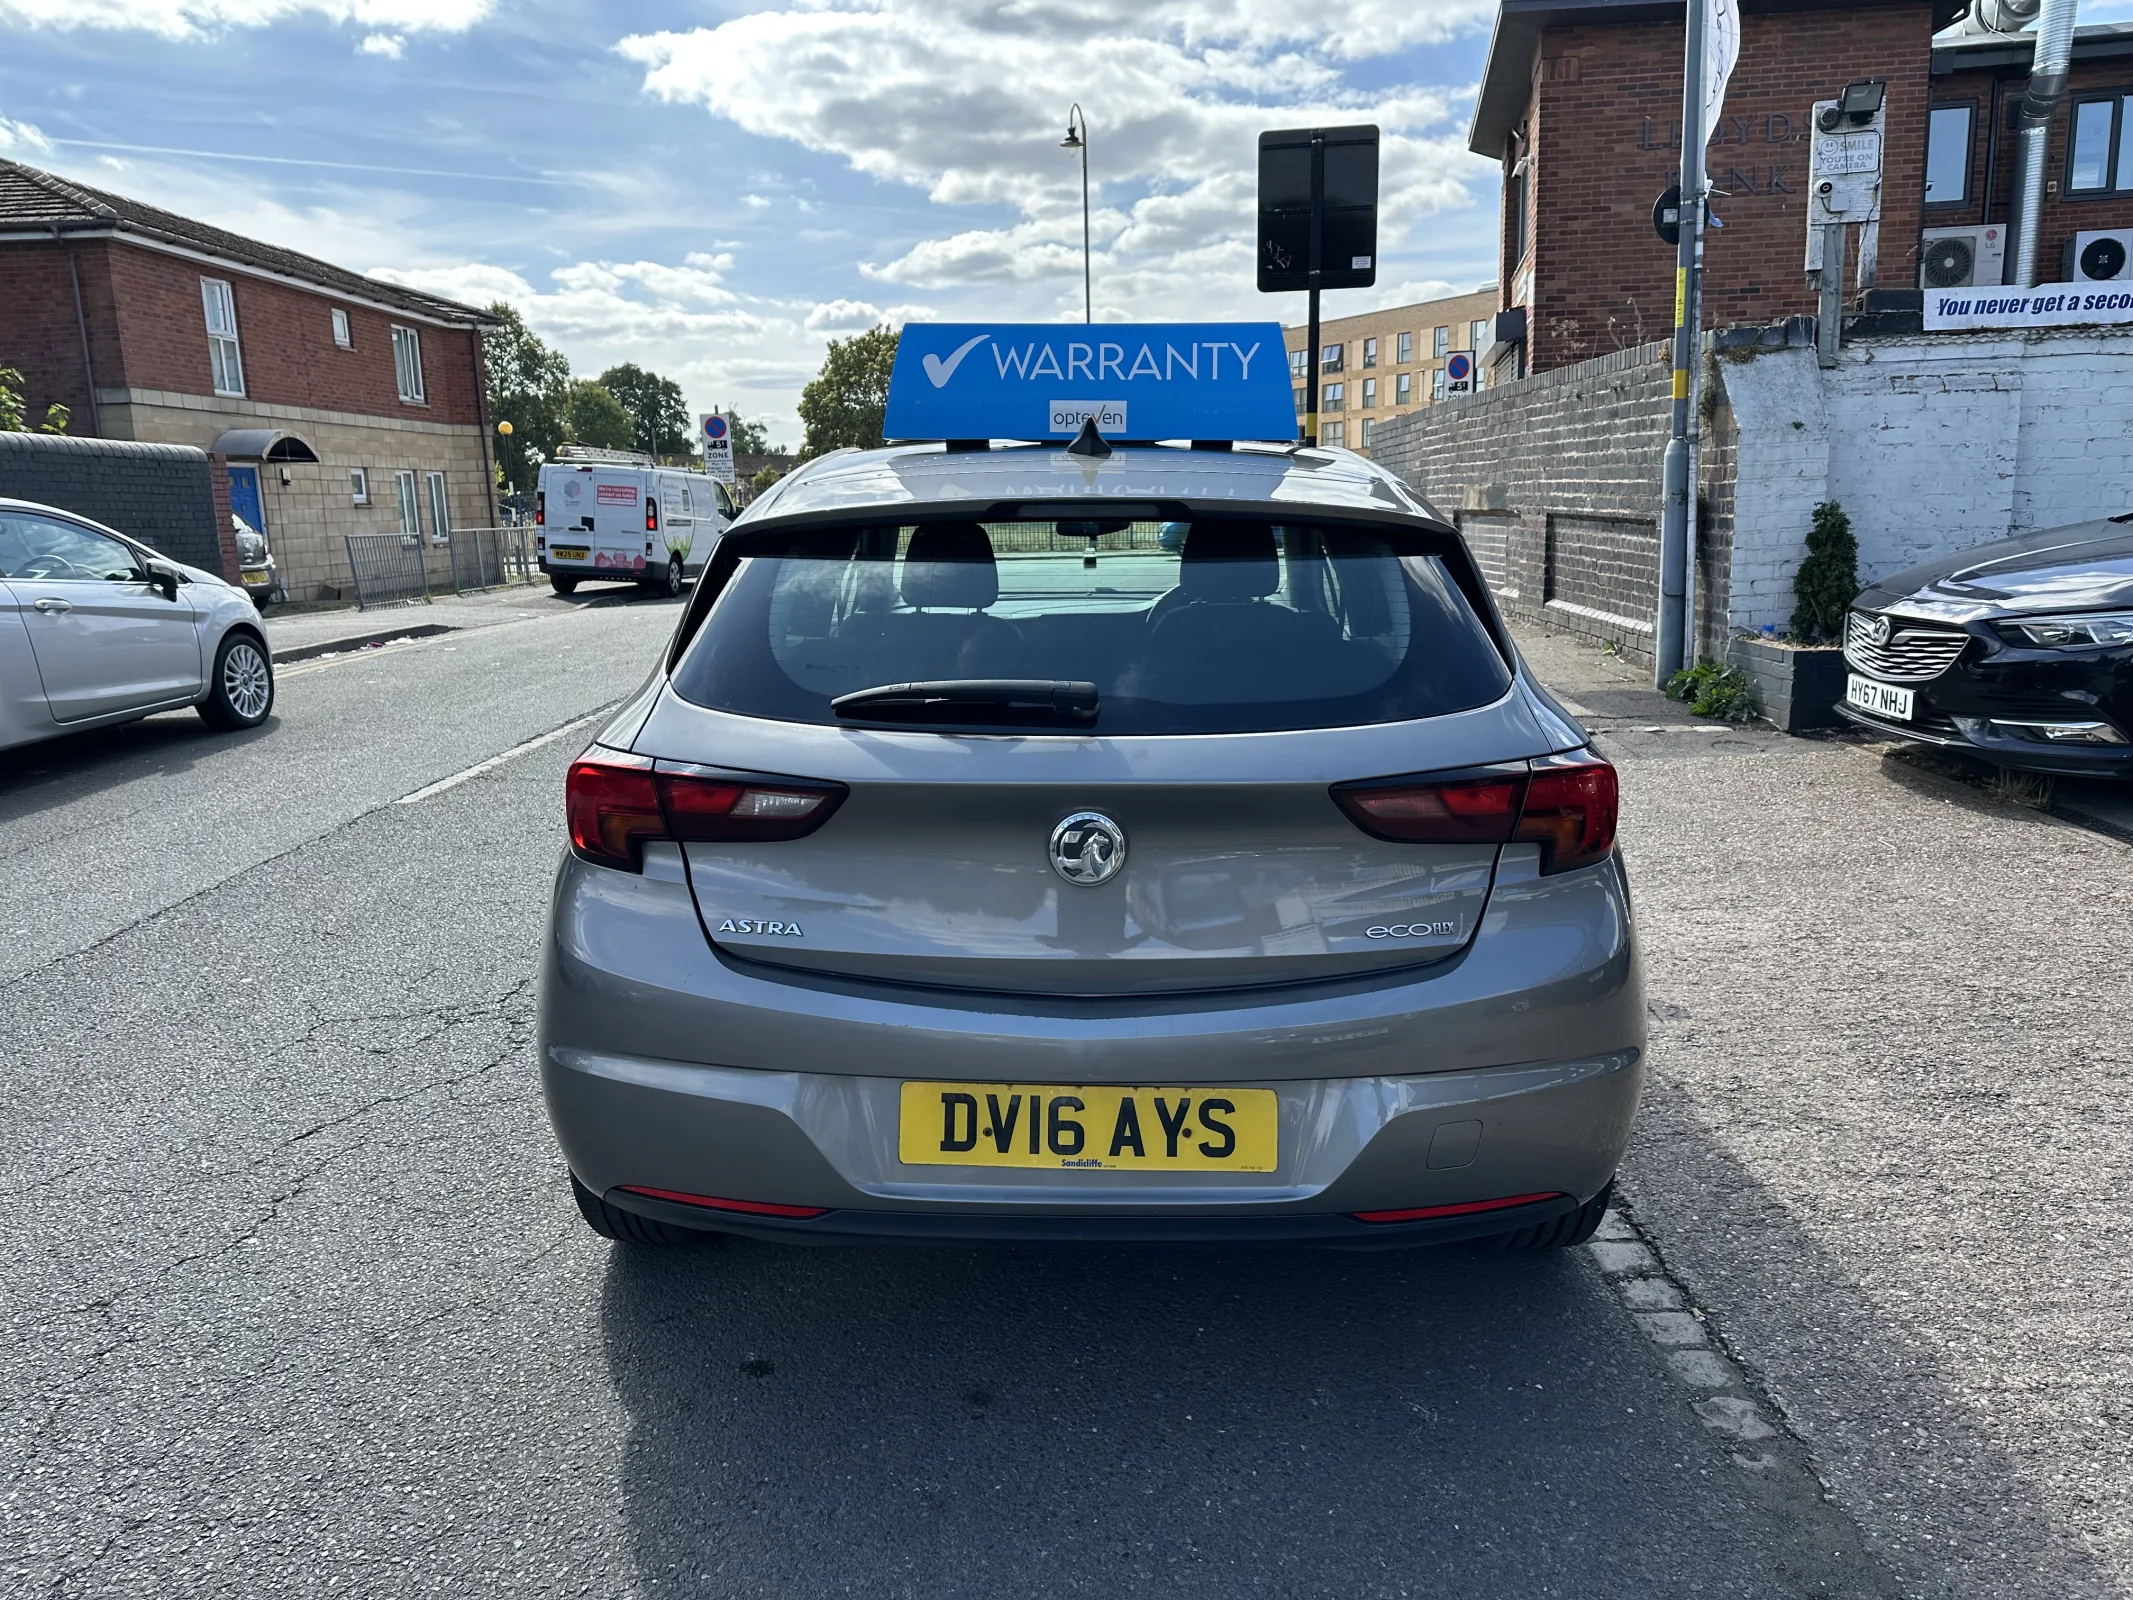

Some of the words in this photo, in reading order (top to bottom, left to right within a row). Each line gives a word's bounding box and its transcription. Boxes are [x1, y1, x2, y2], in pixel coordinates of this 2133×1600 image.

[1839, 139, 1874, 152] SMILE
[1820, 154, 1855, 164] YOU'RE
[1857, 153, 1873, 162] ON
[1827, 161, 1867, 171] CAMERA
[1938, 298, 1971, 316] You
[1973, 298, 2030, 314] never
[2031, 294, 2066, 314] get
[2067, 295, 2081, 311] a
[991, 342, 1262, 381] WARRANTY
[1851, 679, 1878, 706] HY67
[1880, 688, 1907, 714] NHJ
[718, 919, 803, 937] ASTRA
[940, 1092, 1086, 1155] DV16
[1108, 1097, 1236, 1159] AYS
[1061, 1158, 1103, 1168] Sandicliffe
